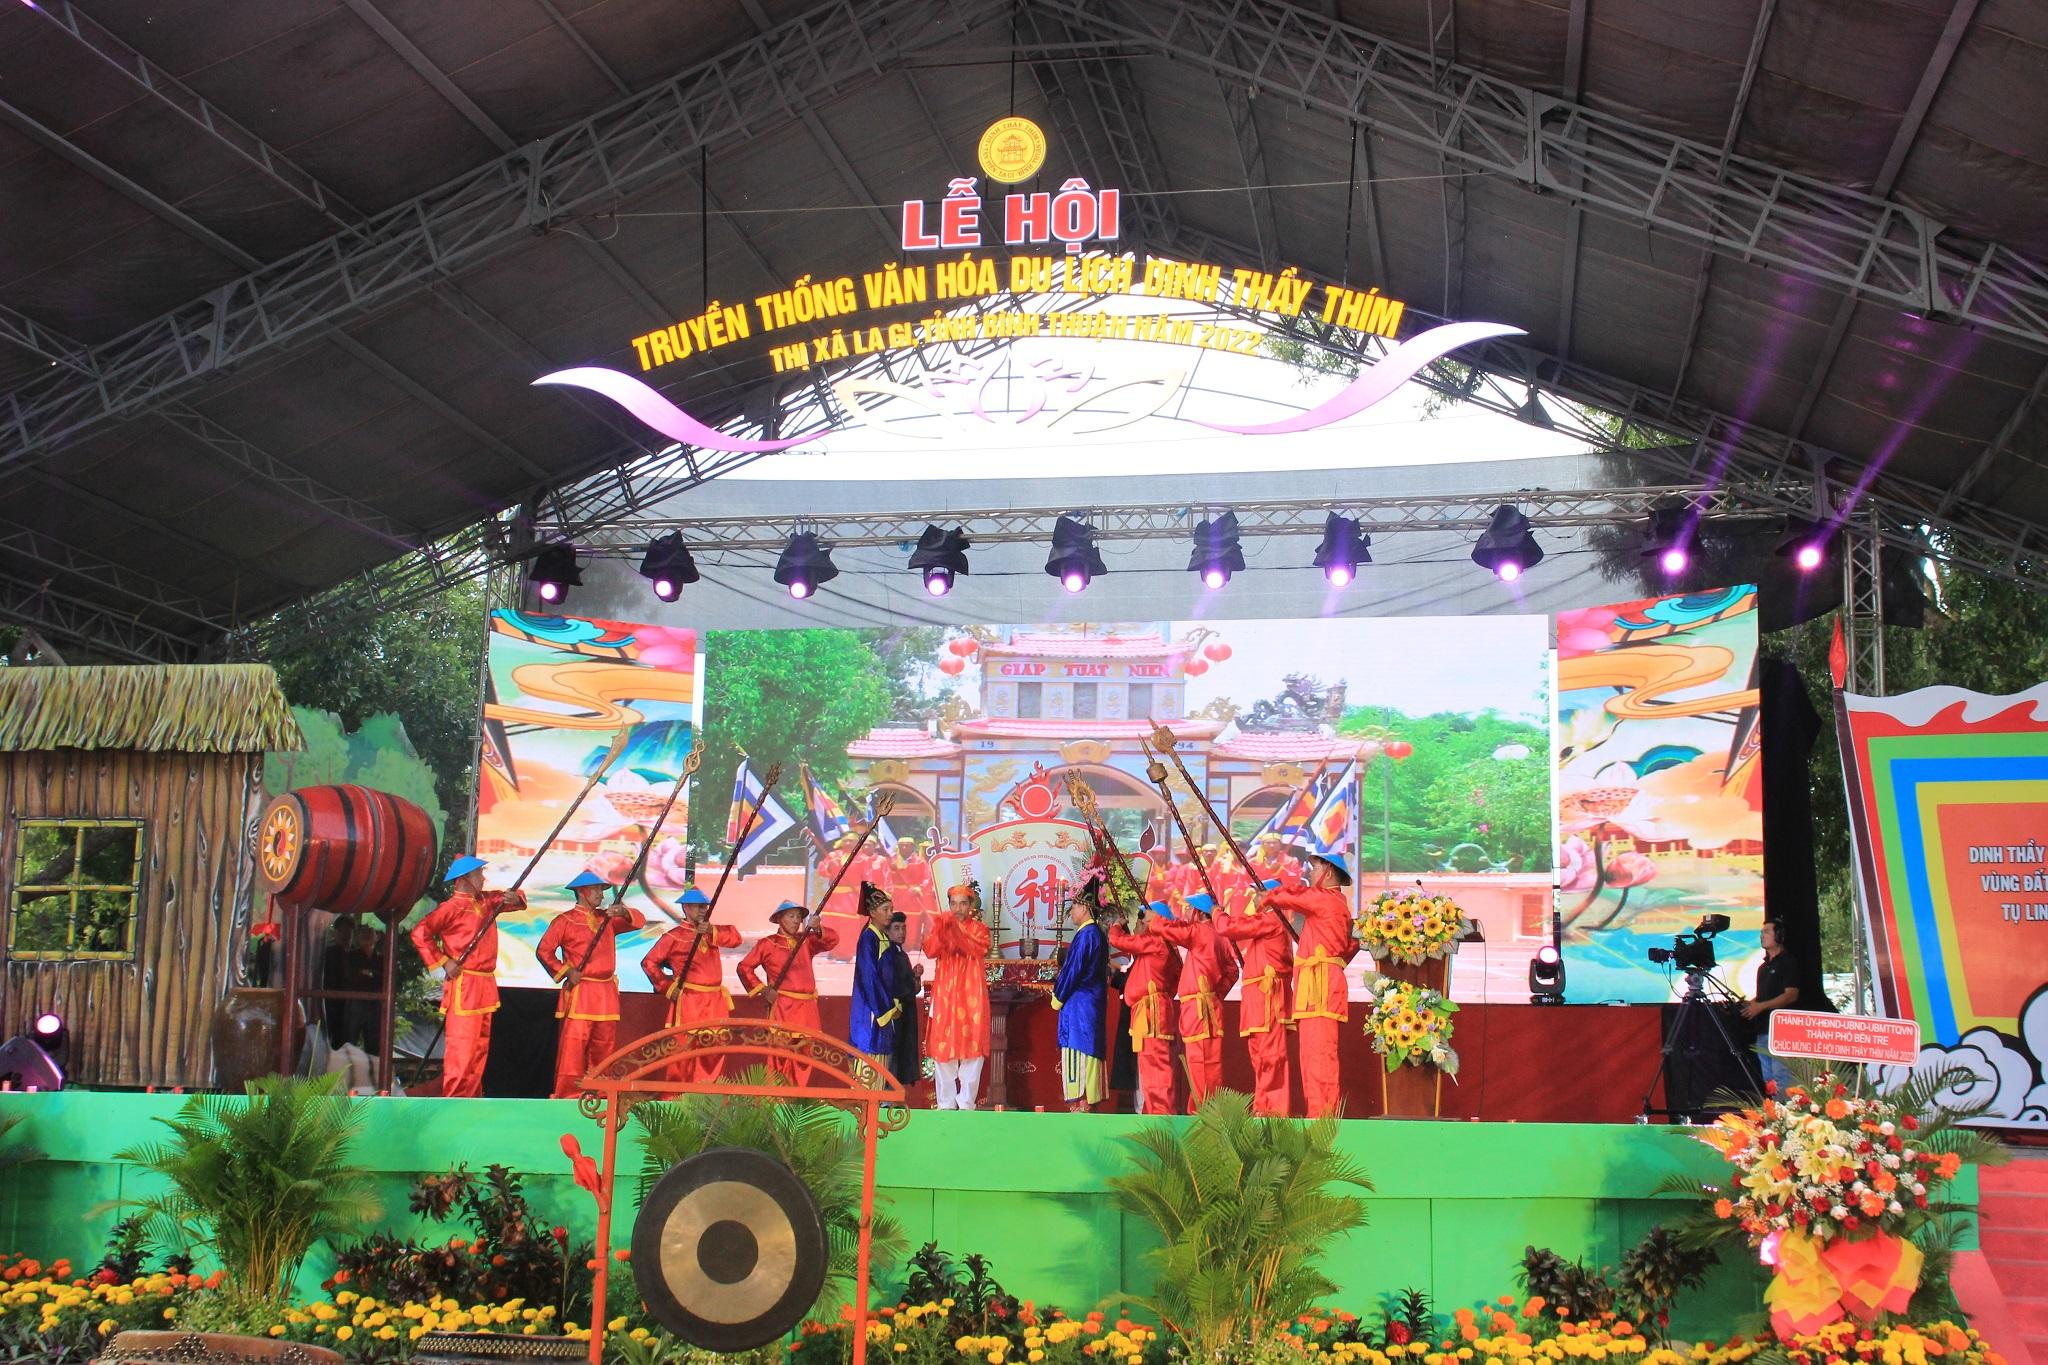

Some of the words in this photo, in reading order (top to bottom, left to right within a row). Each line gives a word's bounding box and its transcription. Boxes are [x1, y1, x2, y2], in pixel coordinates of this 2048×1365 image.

[901, 176, 982, 250] LỄ
[1004, 177, 1120, 254] HỘI
[631, 299, 750, 371] TRUYỀN
[755, 273, 857, 332] THỐNG
[863, 261, 927, 309] VĂN
[936, 252, 998, 299] HÓA
[1010, 256, 1052, 294] DU
[1063, 256, 1135, 300] LỊCH
[1143, 258, 1221, 302] DINH
[1231, 266, 1313, 318] THẦY
[1320, 285, 1405, 338] THÍM
[769, 341, 810, 373] THỊ
[813, 329, 850, 363] XÃ
[853, 326, 885, 355] LA
[921, 309, 977, 342] TỈNH
[982, 310, 1040, 339] BÌNH
[1048, 309, 1128, 343] THUẬN
[1133, 313, 1194, 347] NĂM
[1199, 324, 1263, 357] 2022
[1968, 845, 2004, 864] DINH
[2007, 839, 2046, 864] THẦY
[1012, 864, 1069, 920] 神
[1980, 870, 2020, 893] VÙNG
[2001, 903, 2021, 925] TỤ
[1776, 1015, 1804, 1026] THÀNH
[1806, 1029, 1834, 1041] THÀNH
[1872, 1036, 1888, 1046] TRE
